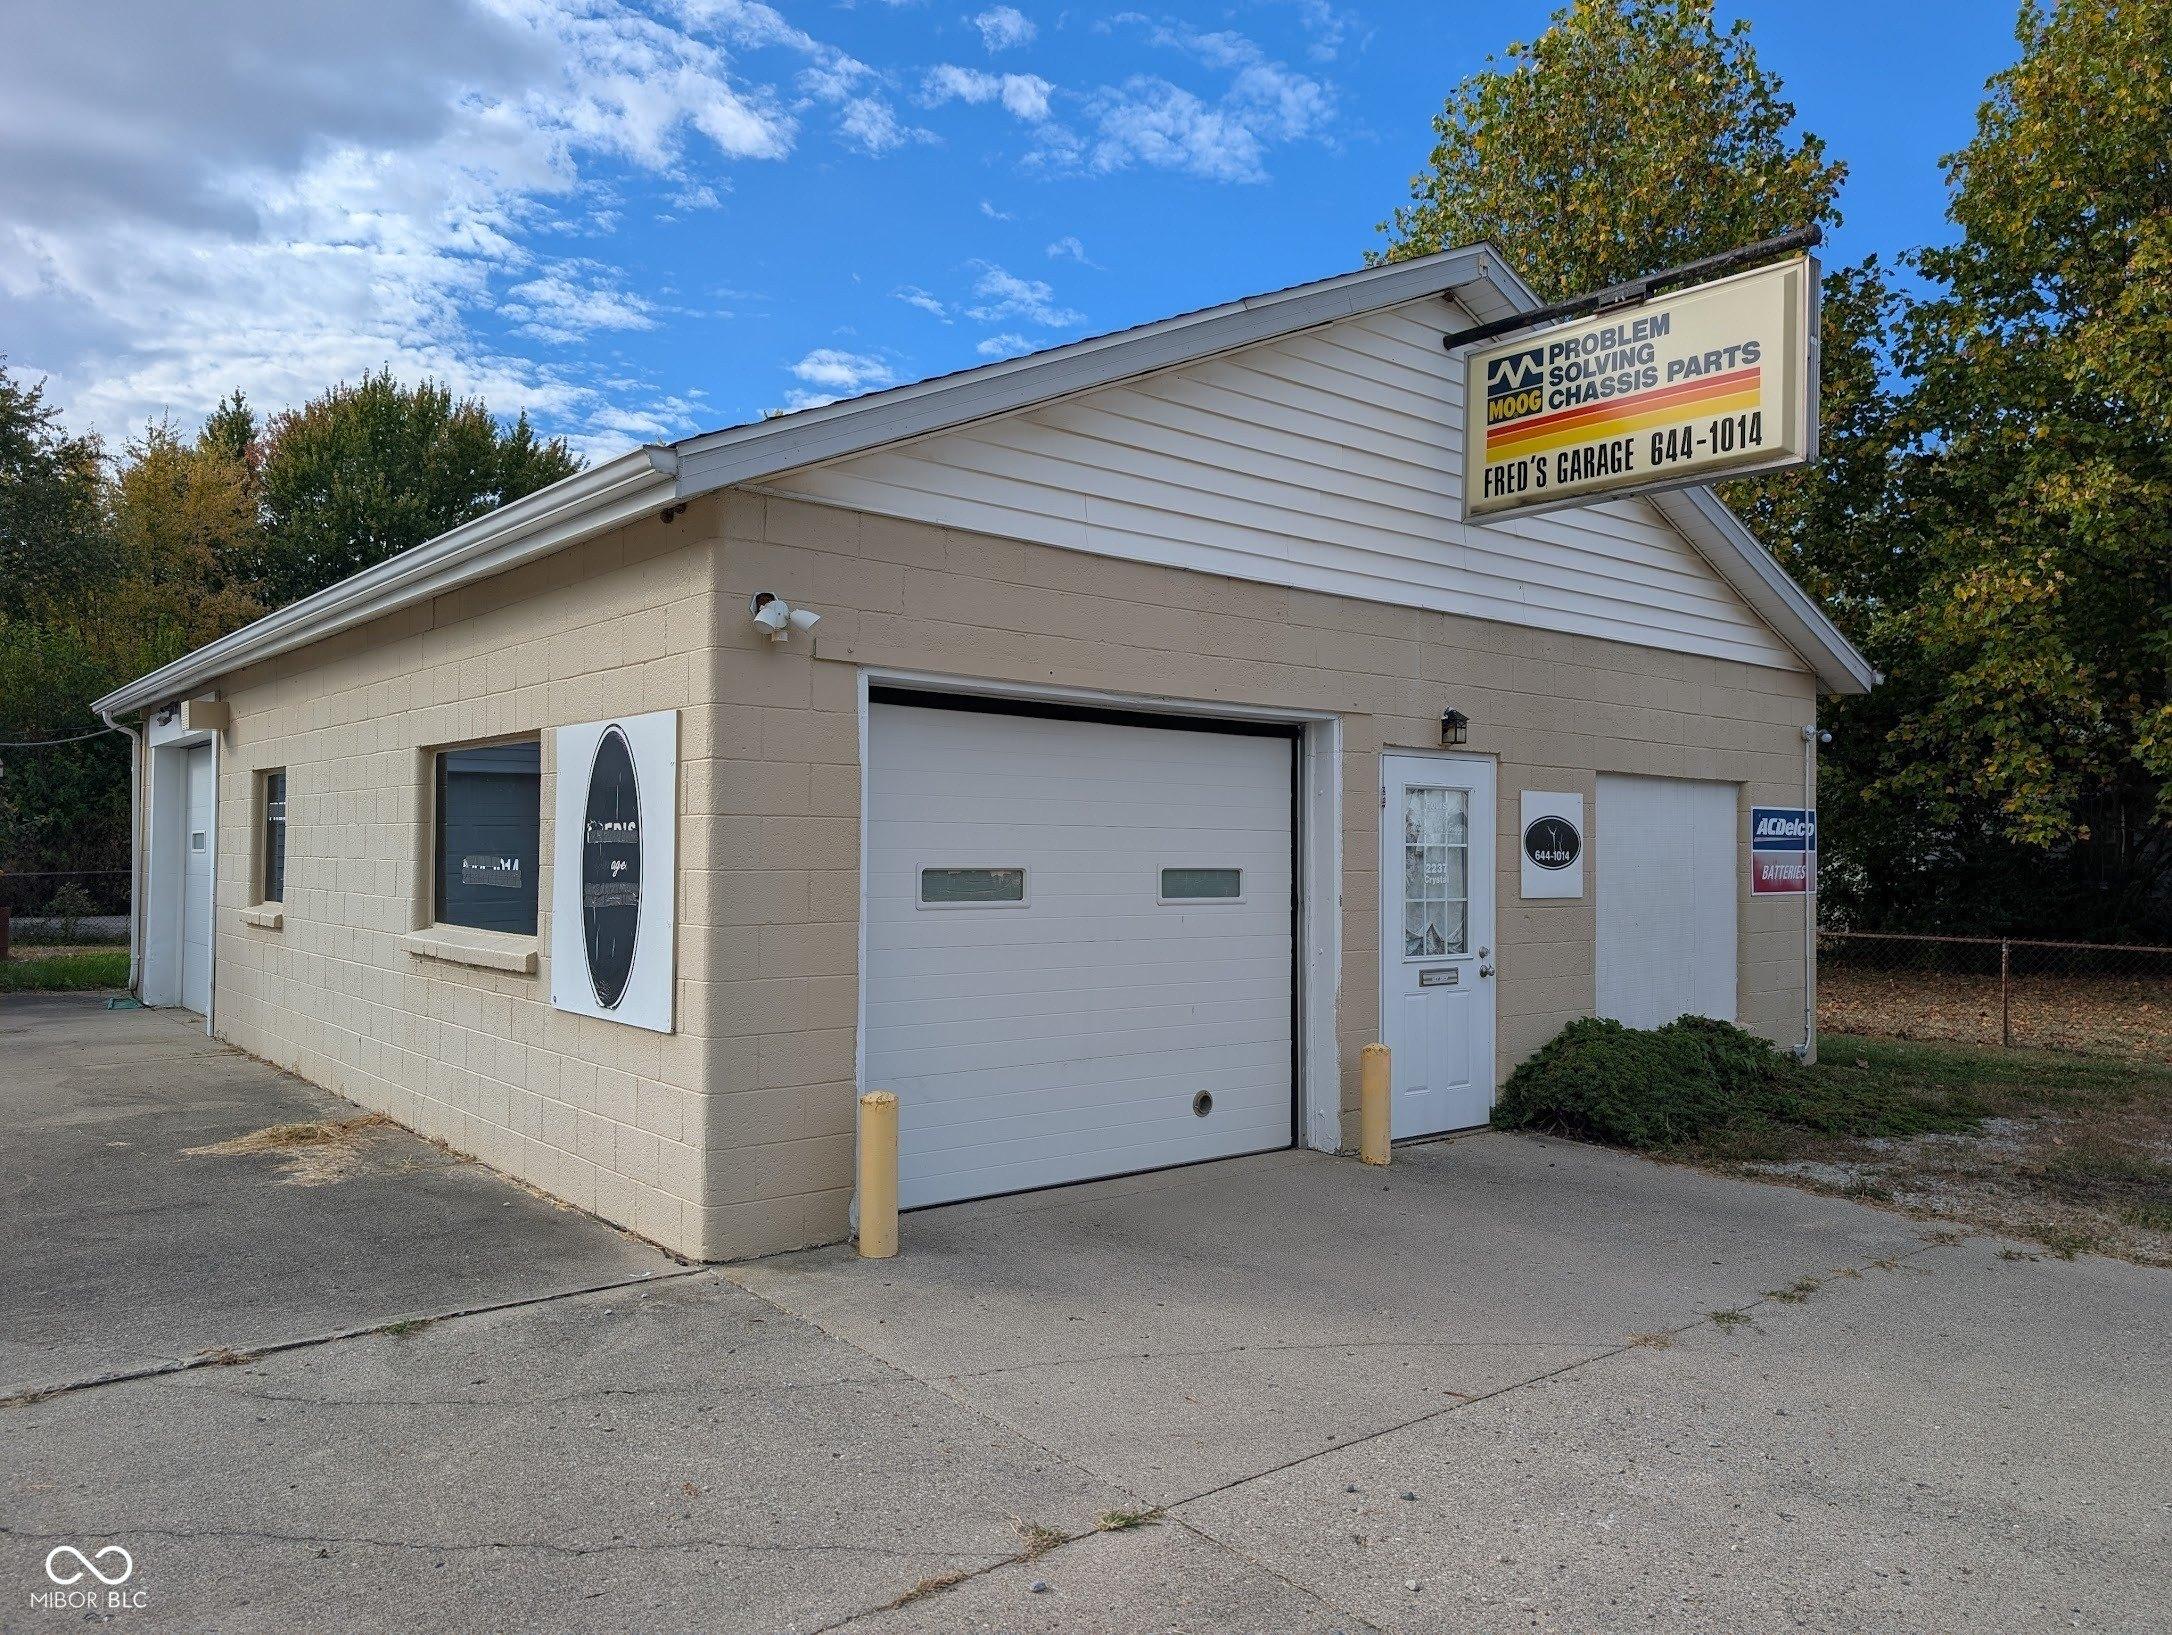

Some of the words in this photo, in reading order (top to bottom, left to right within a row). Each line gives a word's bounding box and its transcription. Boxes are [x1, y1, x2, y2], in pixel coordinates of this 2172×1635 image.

[1549, 313, 1671, 365] PROBLEM
[1548, 366, 1659, 410] CHASSIS
[1667, 341, 1762, 382] PARTS
[1549, 343, 1655, 387] SOLVING
[1489, 389, 1542, 422] MOOG
[1484, 455, 1548, 499] FRED'S
[1556, 437, 1635, 485] GARAGE
[1650, 411, 1763, 466] 644-1014
[1756, 817, 1815, 837] ACDelco
[1425, 862, 1448, 874] 2237
[1534, 849, 1570, 861] 644-1014
[1424, 875, 1450, 885] Crystal
[1761, 865, 1806, 880] BATTERIES
